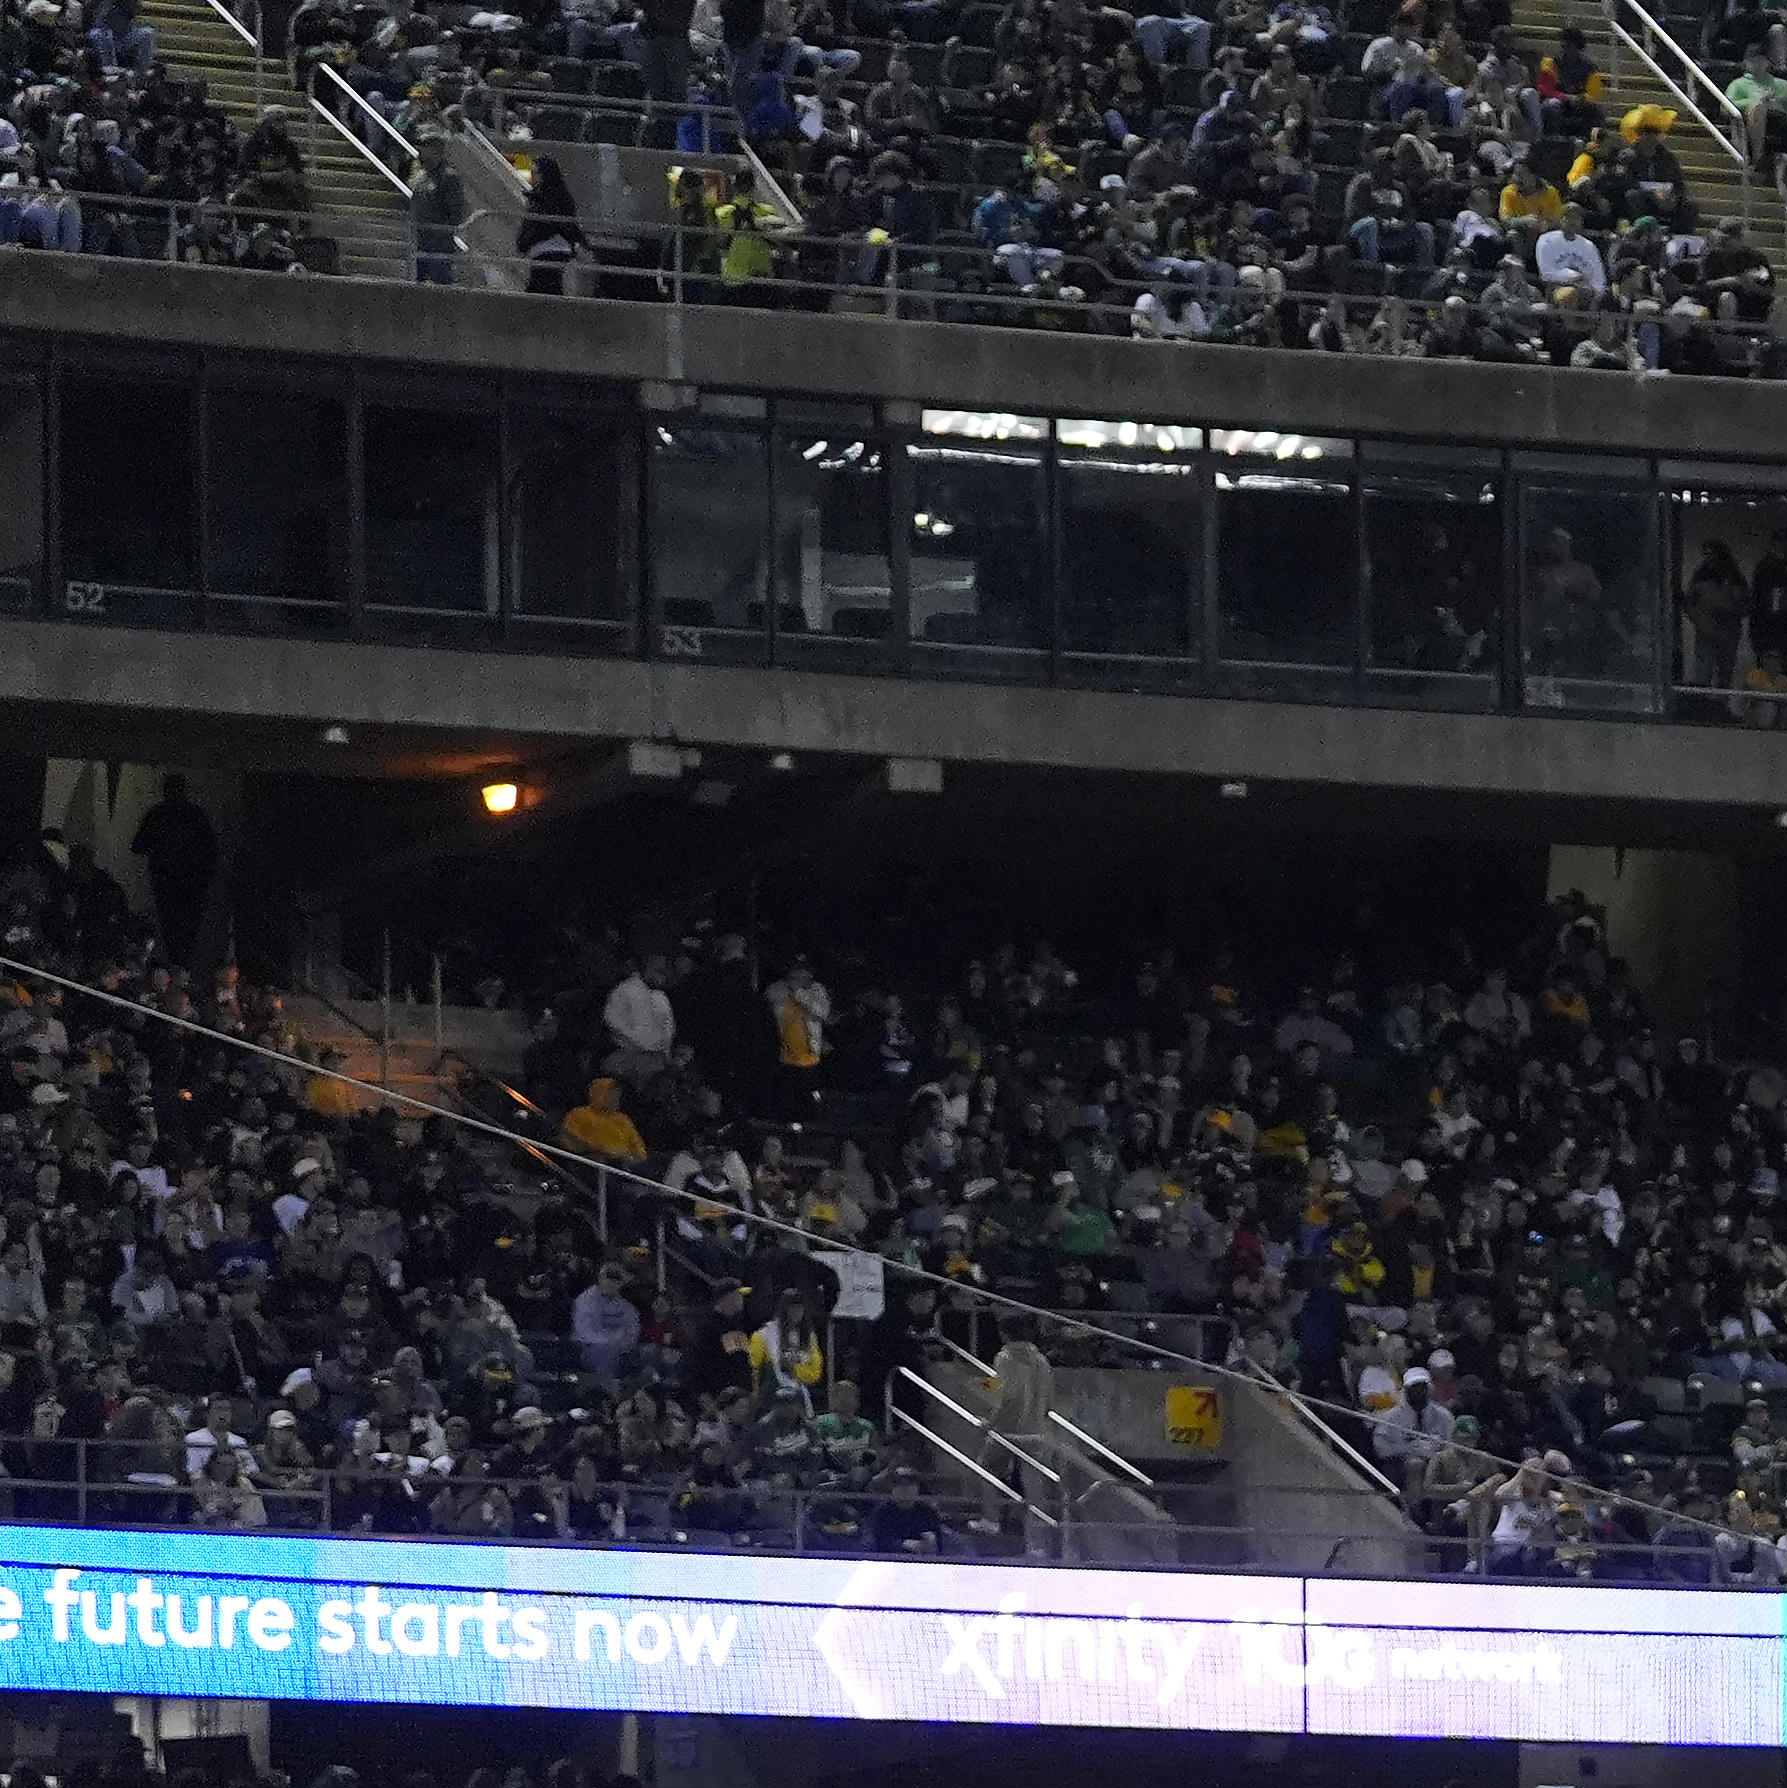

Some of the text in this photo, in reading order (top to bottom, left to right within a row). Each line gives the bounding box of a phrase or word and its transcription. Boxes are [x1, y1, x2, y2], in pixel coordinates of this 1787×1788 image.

[66, 581, 106, 612] 52
[43, 1568, 294, 1652] future
[318, 1587, 549, 1661] starts
[574, 1610, 739, 1667] now
[940, 1590, 1201, 1705] xfinity
[1390, 1640, 1564, 1685] network
